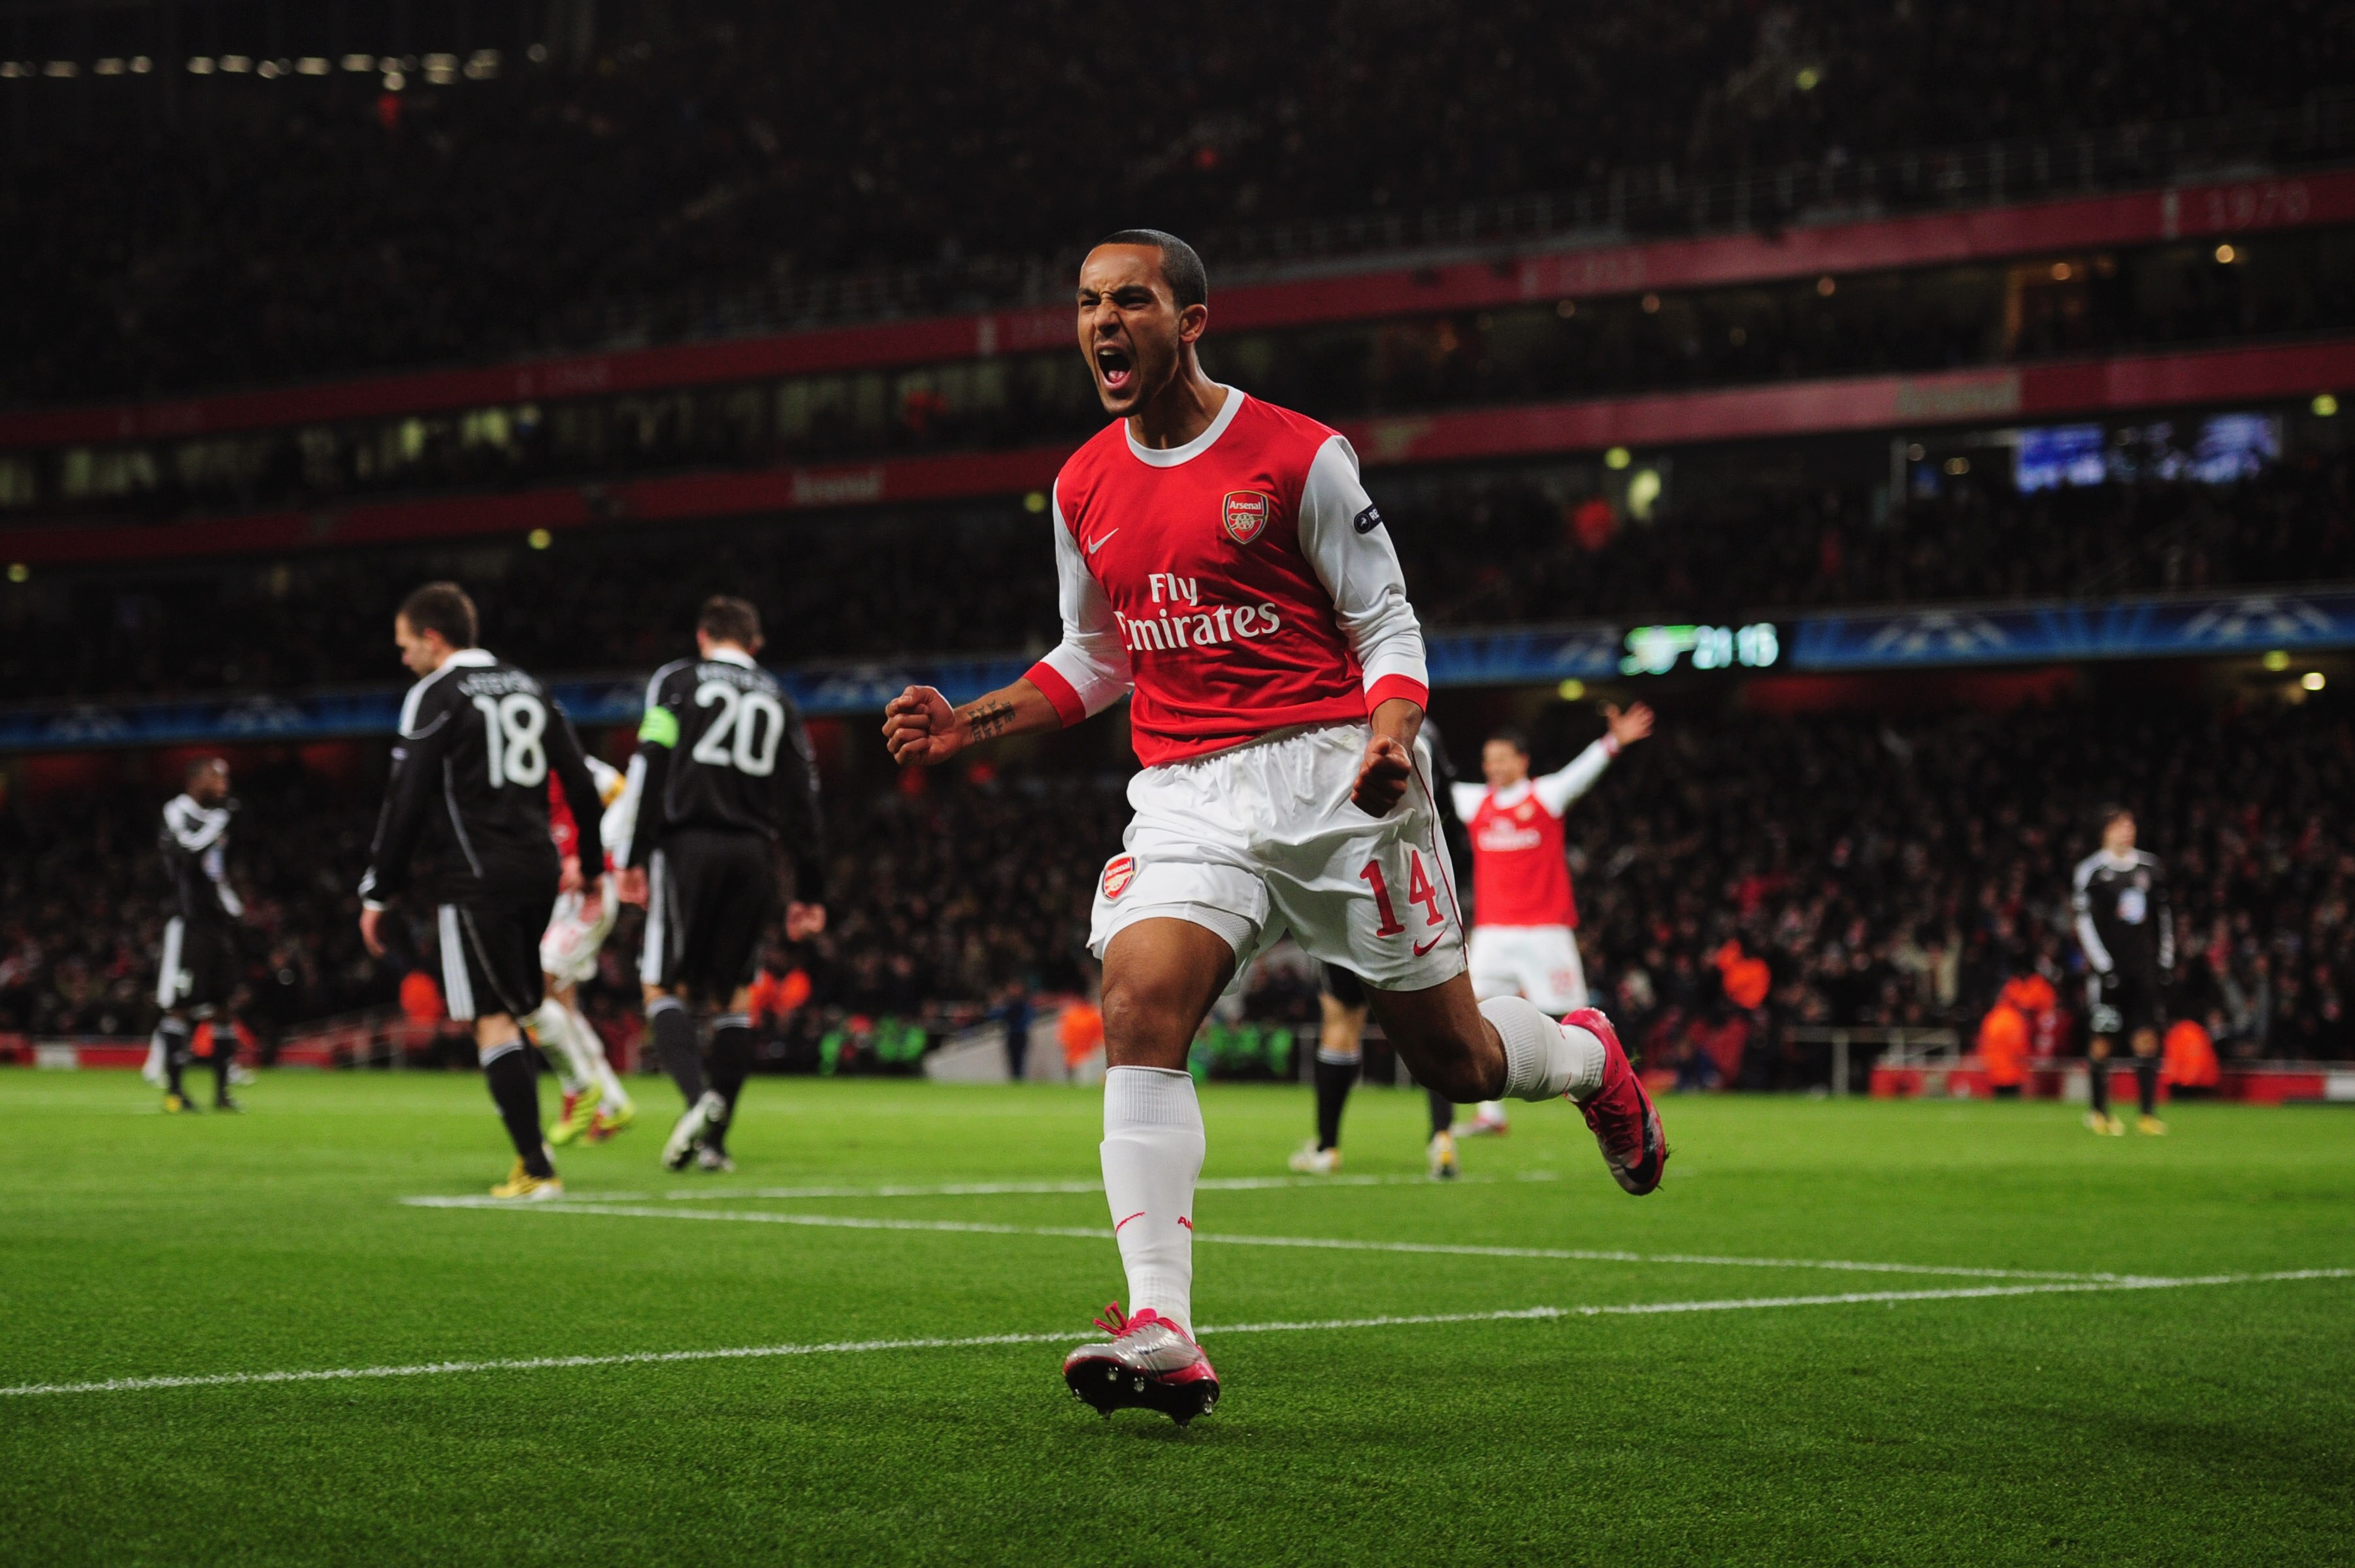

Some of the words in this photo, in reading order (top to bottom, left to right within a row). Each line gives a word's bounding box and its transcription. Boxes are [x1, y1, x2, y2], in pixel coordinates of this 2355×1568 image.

[1229, 500, 1261, 510] Arsenal
[1148, 572, 1198, 607] Fly
[472, 693, 548, 790] 18
[692, 678, 785, 777] 20
[1359, 849, 1445, 938] 14
